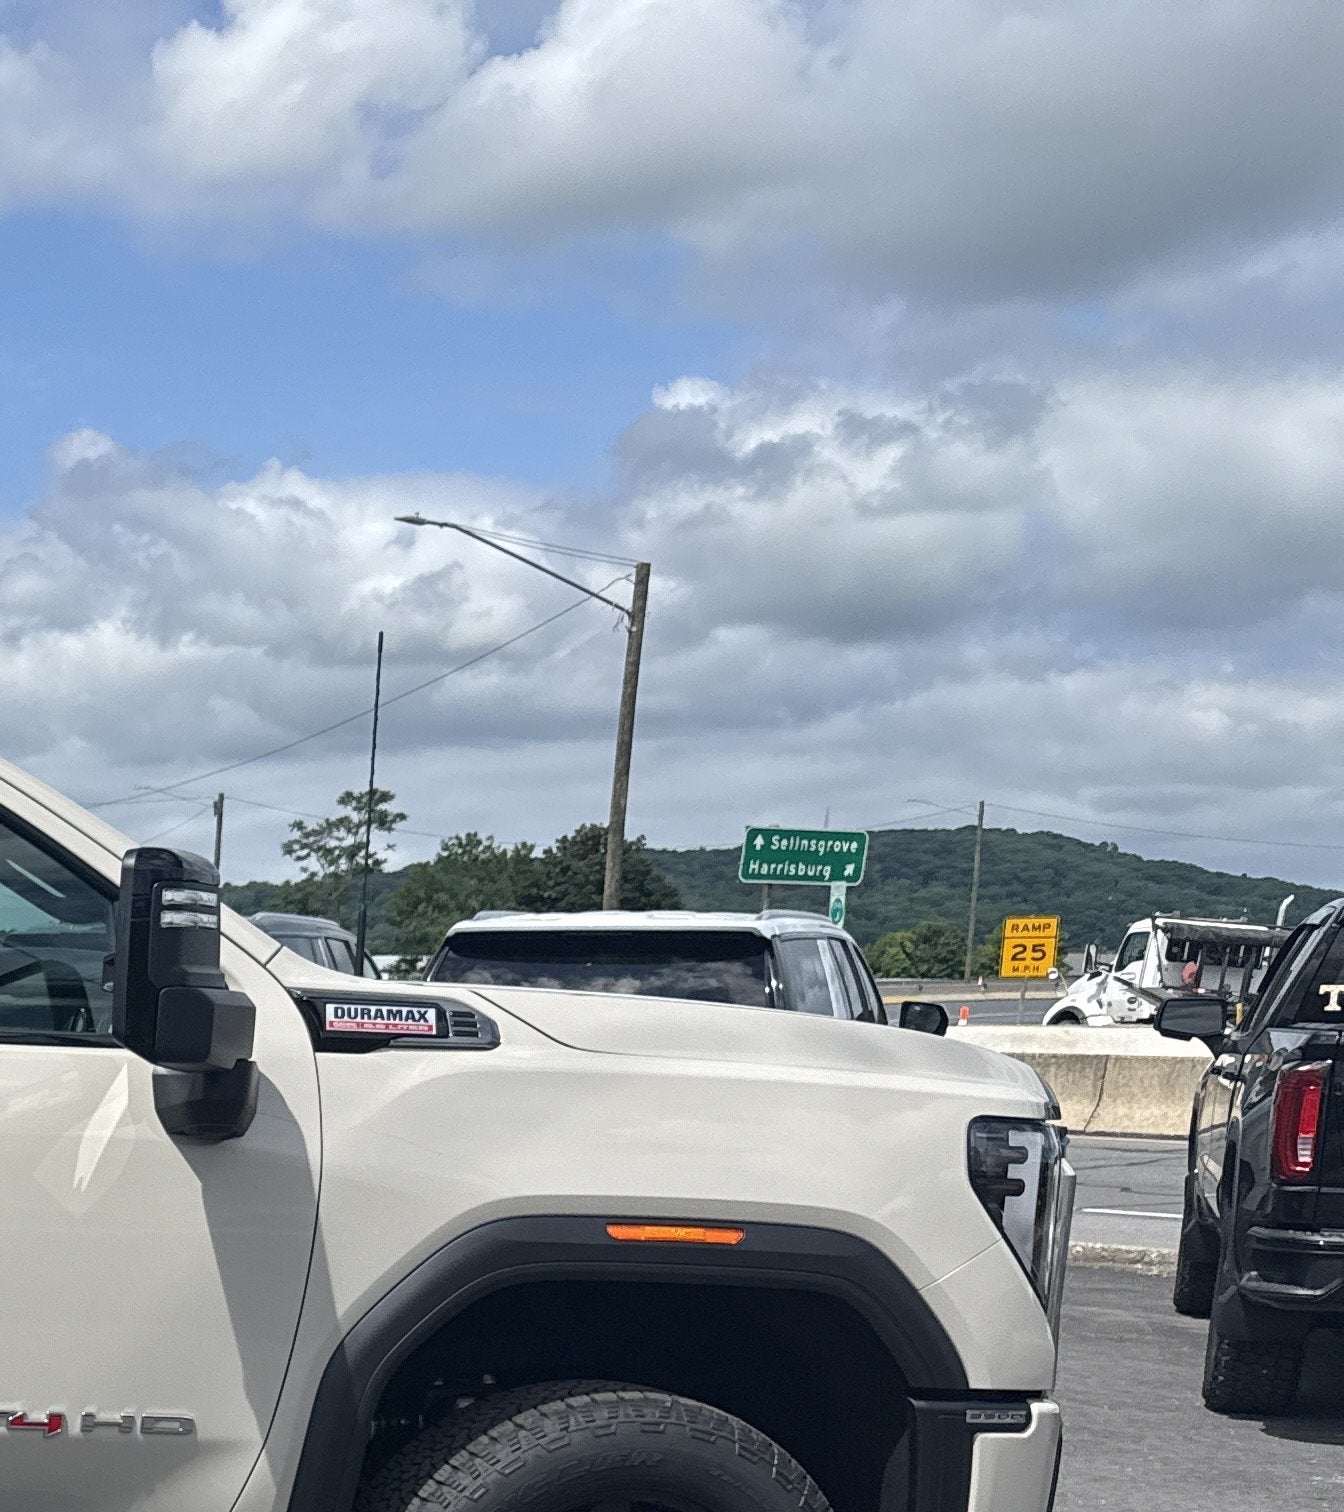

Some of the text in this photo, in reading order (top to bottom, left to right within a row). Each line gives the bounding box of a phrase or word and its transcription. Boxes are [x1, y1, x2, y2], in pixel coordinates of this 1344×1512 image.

[770, 835, 858, 856] Selinsgrove
[749, 859, 831, 881] Harrisburg
[1010, 923, 1052, 933] RAMP
[1010, 943, 1047, 962] 25
[333, 1007, 429, 1023] DURAMAX
[80, 1410, 194, 1435] HD
